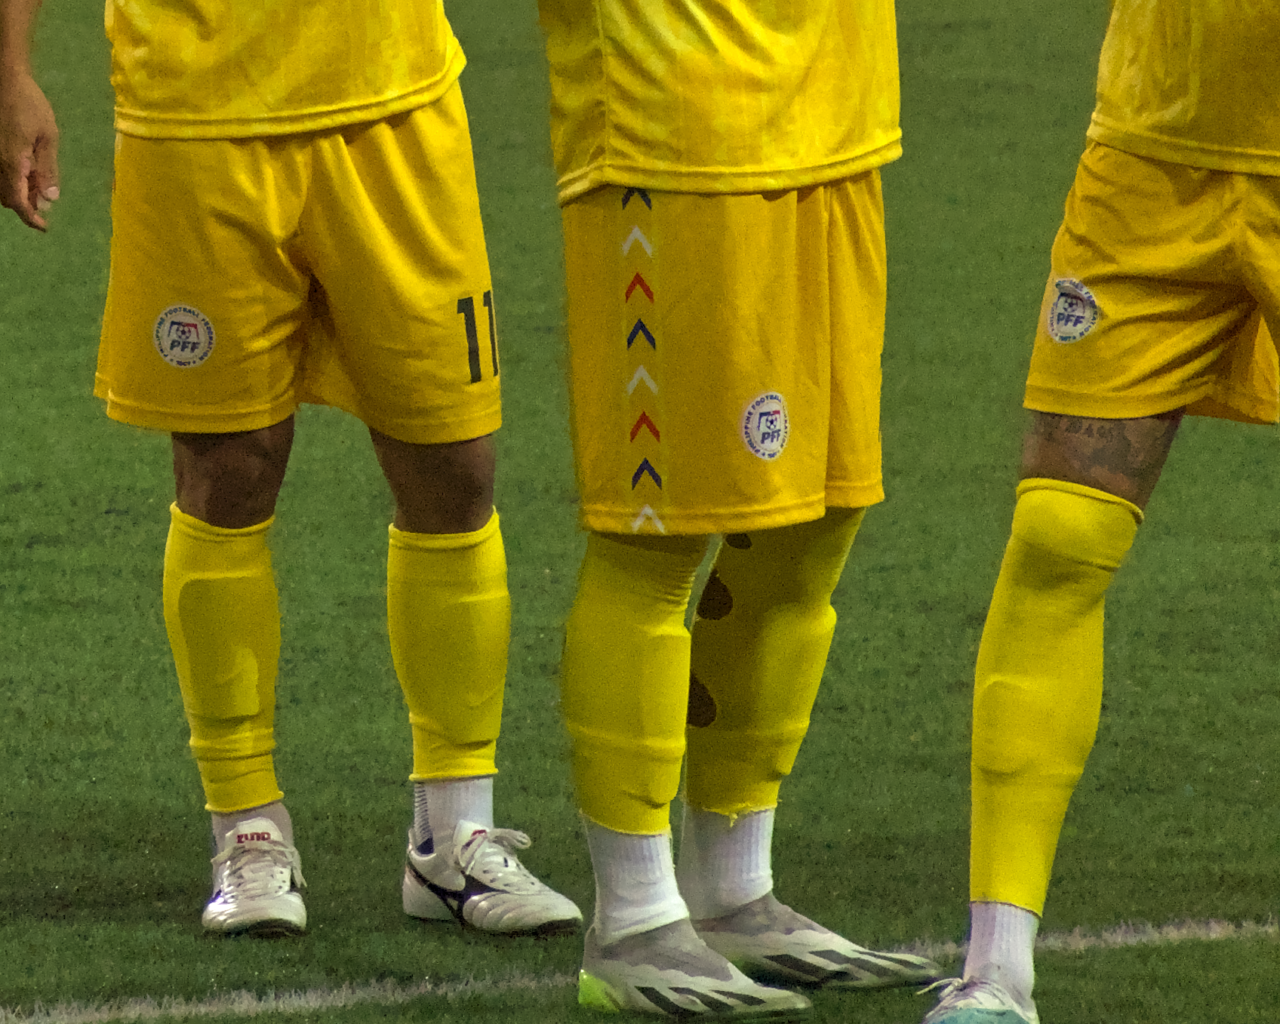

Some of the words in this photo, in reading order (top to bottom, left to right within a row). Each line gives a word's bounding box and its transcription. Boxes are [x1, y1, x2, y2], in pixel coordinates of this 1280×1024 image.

[1057, 312, 1085, 327] PFF
[457, 290, 498, 384] 11
[170, 339, 200, 353] PFF
[760, 429, 781, 444] PFF
